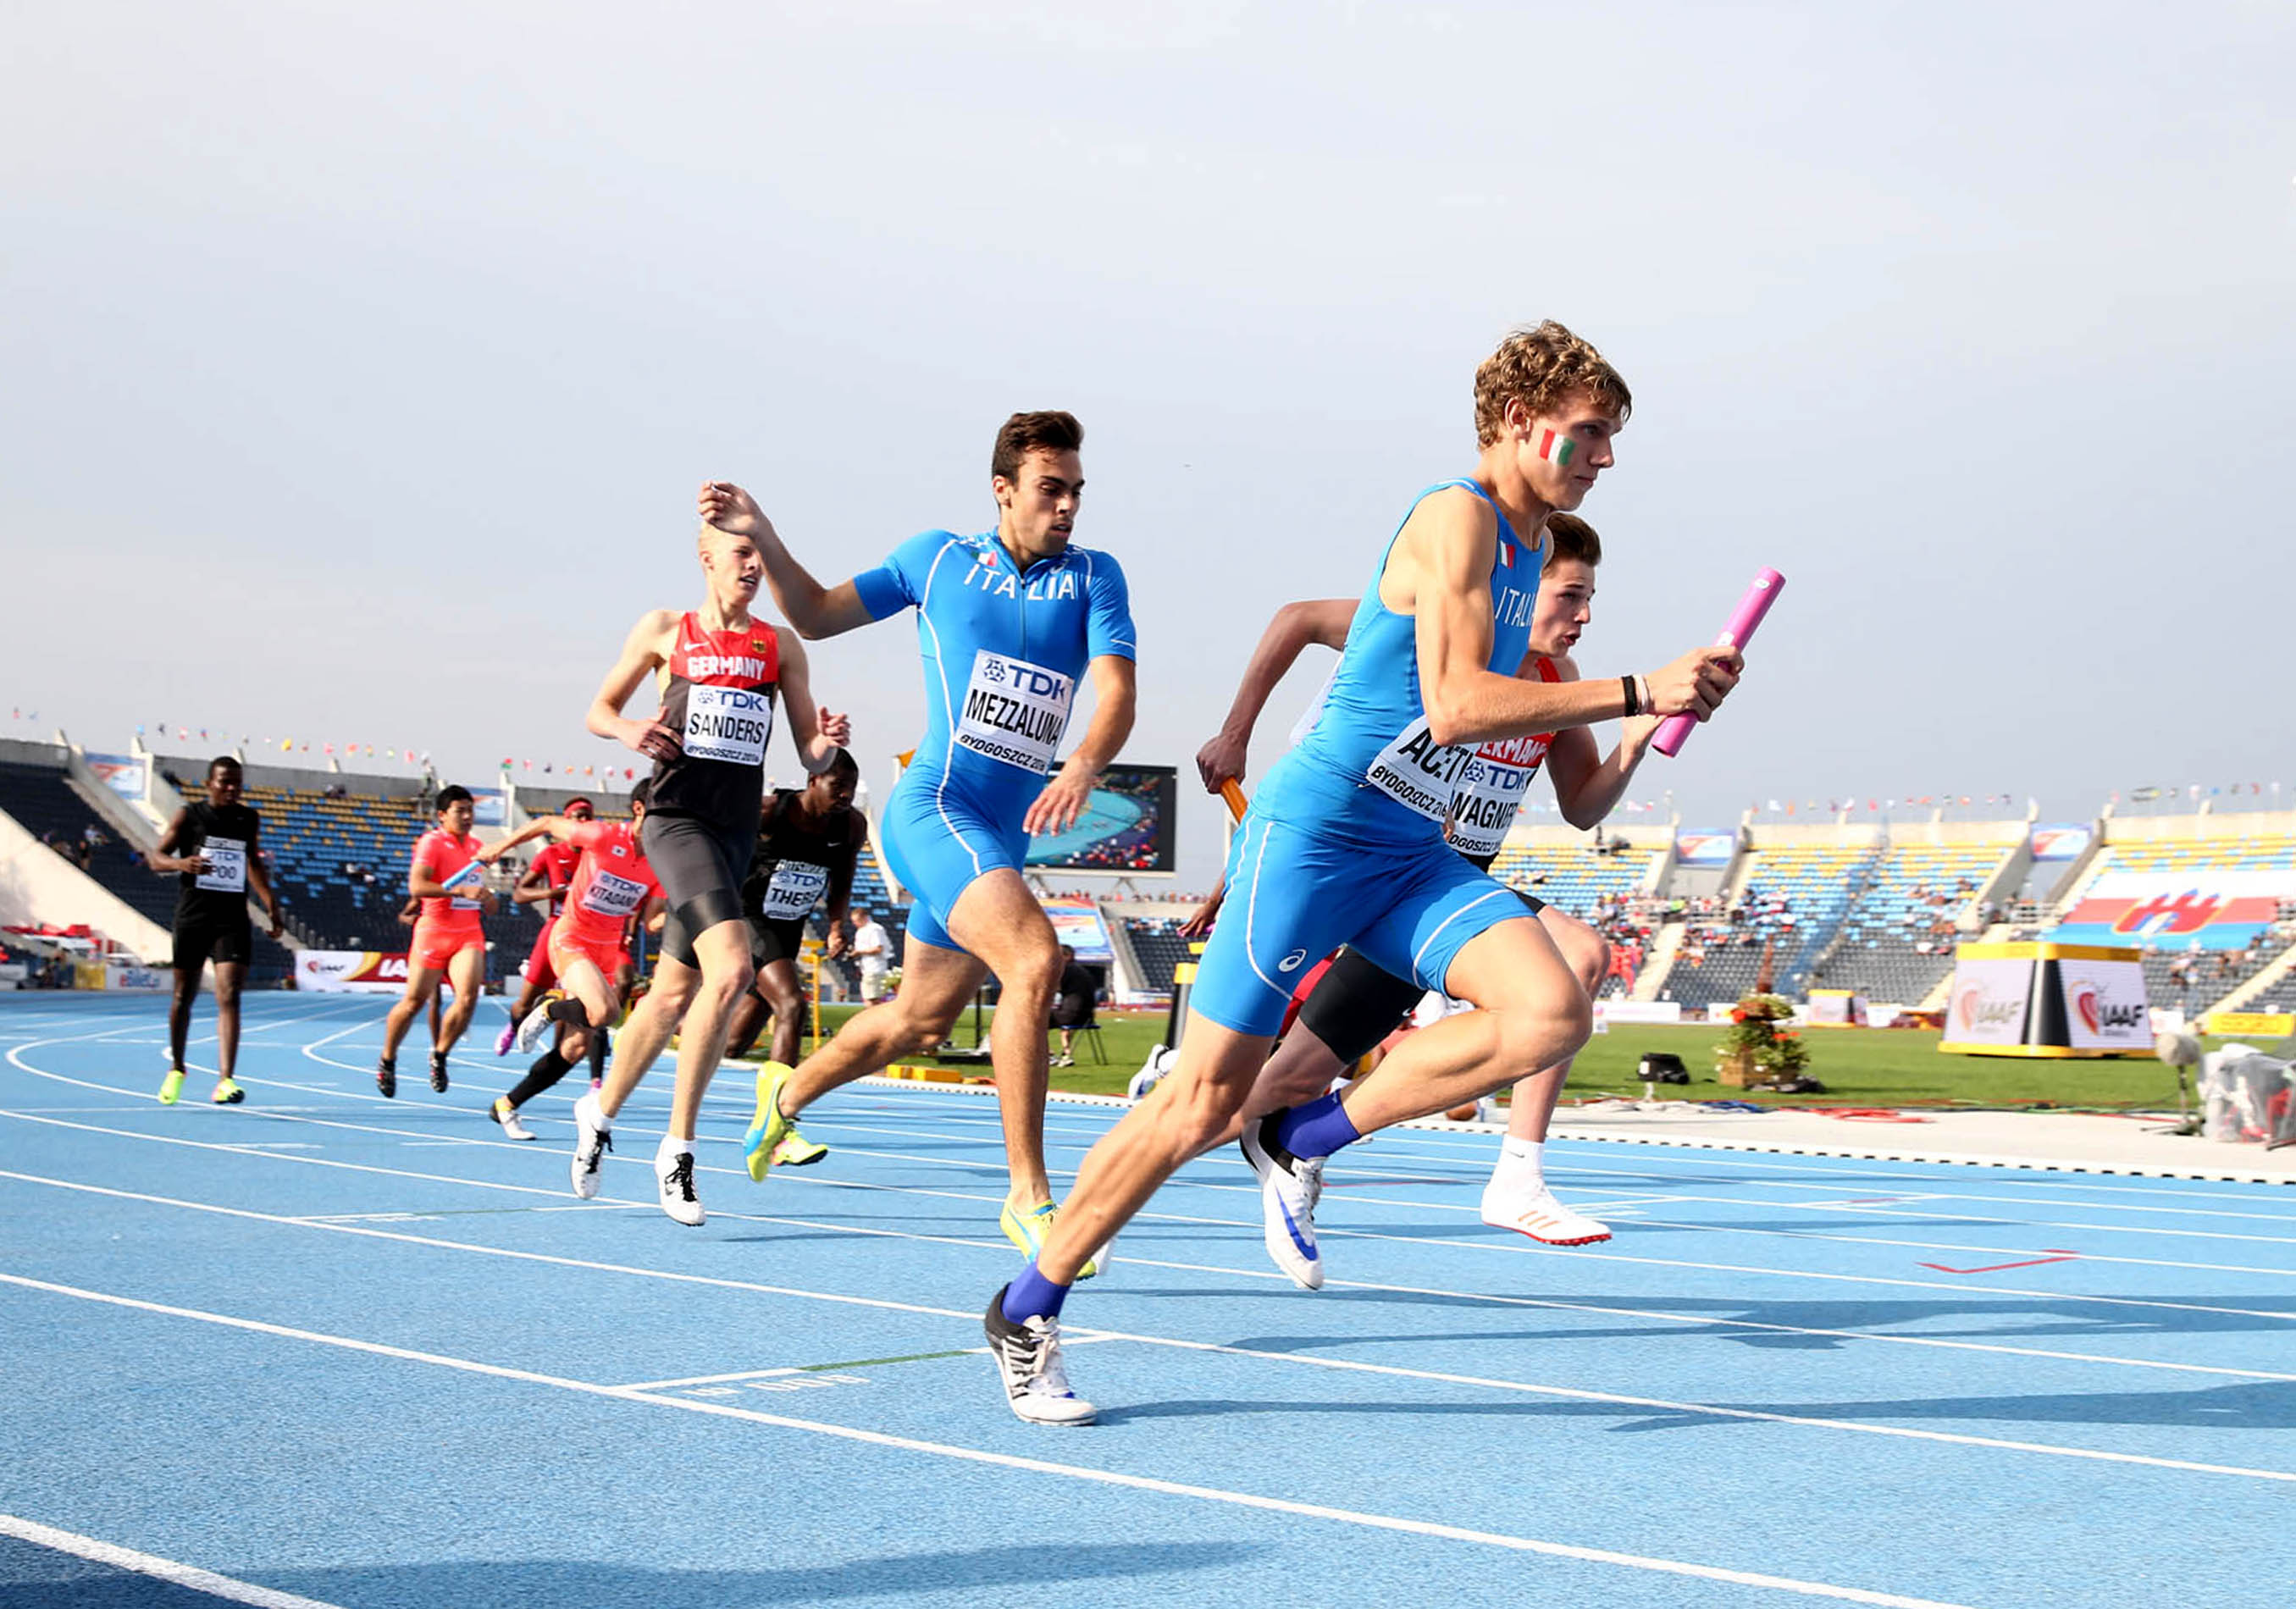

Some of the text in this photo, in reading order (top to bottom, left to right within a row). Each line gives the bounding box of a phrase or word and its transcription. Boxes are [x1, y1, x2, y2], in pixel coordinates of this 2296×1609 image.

[963, 563, 1076, 600] ITALIA
[1495, 586, 1535, 628] ITALI
[687, 655, 766, 681] GERMANY
[1008, 664, 1065, 705] TDK
[715, 689, 764, 712] TDK
[689, 712, 765, 744] SANDERS
[965, 688, 1064, 747] MEZZALUNA
[960, 733, 1032, 766] BYDGOSZCZ
[1480, 737, 1548, 765] ERMAN
[1487, 764, 1531, 790] TDK
[611, 876, 645, 893] TDK
[792, 872, 826, 887] TDK
